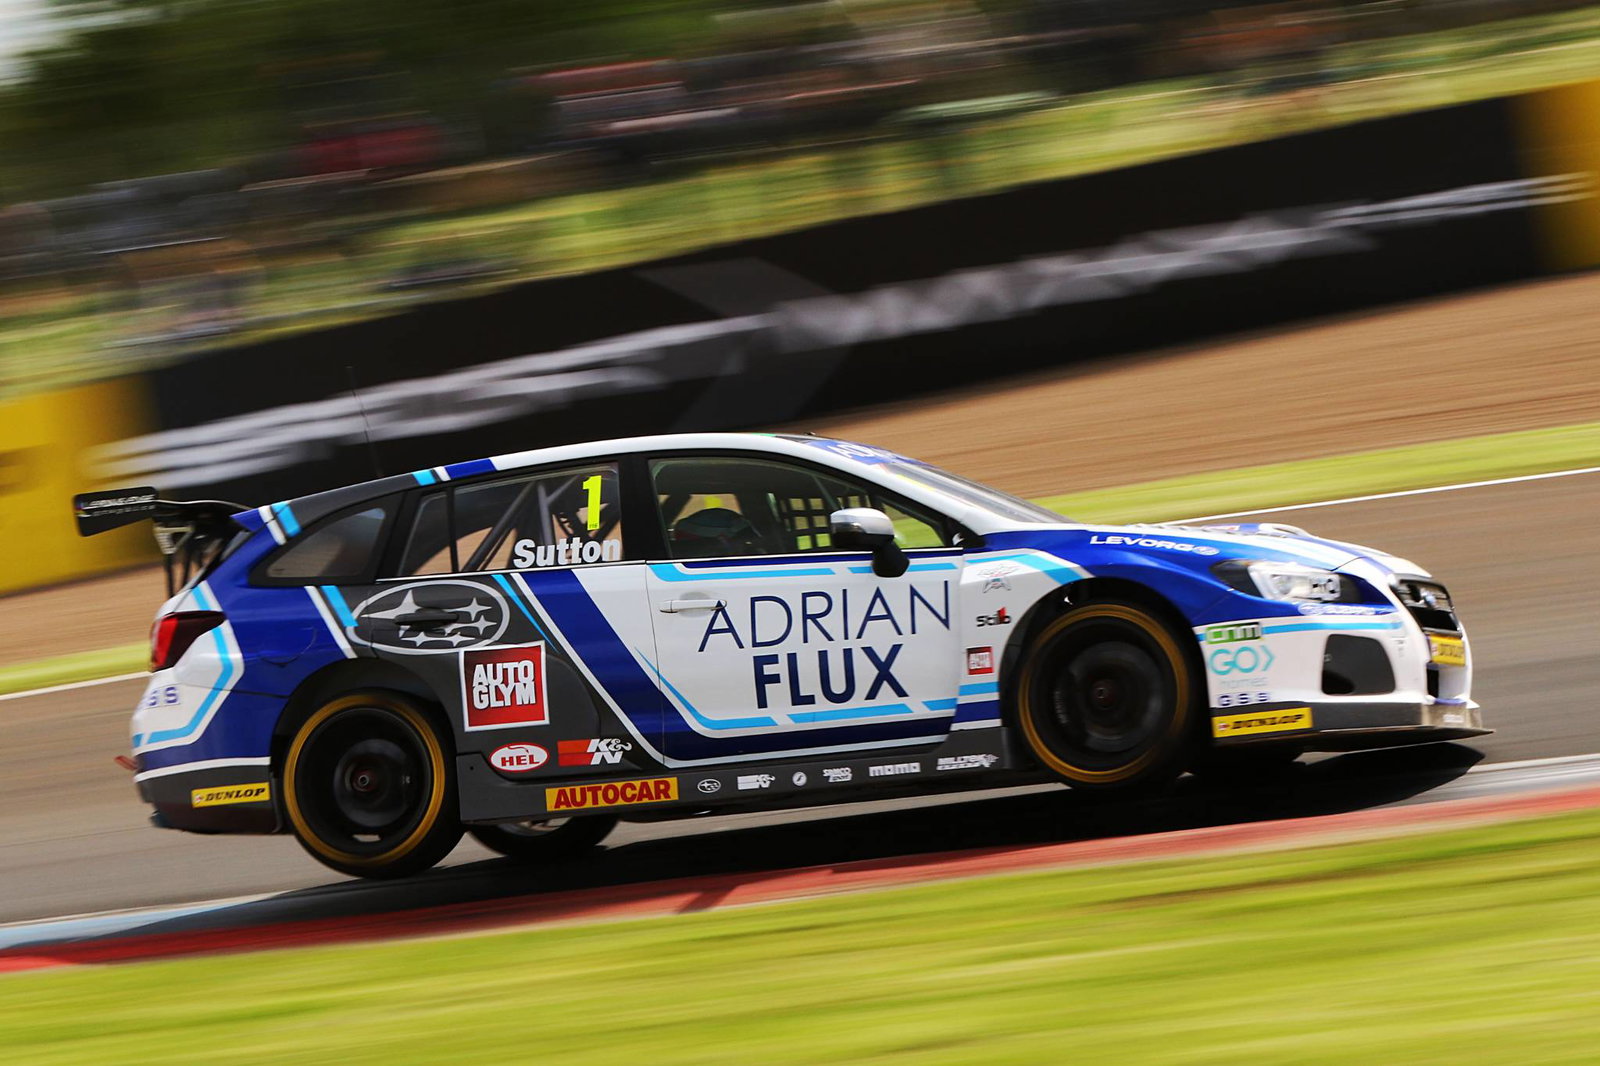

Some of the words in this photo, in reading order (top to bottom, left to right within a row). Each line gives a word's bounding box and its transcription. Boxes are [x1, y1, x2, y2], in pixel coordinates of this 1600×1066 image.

[583, 475, 602, 530] 1
[513, 537, 621, 569] Sutton
[1090, 535, 1195, 552] LEVORG
[698, 580, 951, 653] ADRIAN
[472, 660, 535, 688] AUTO
[752, 644, 909, 709] FLUX
[473, 682, 536, 709] GLYM
[1231, 714, 1304, 730] DUNLOP
[501, 754, 539, 766] HEL
[868, 762, 921, 777] momo
[204, 787, 266, 801] DUNLOP
[554, 780, 672, 809] AUTOCAR
